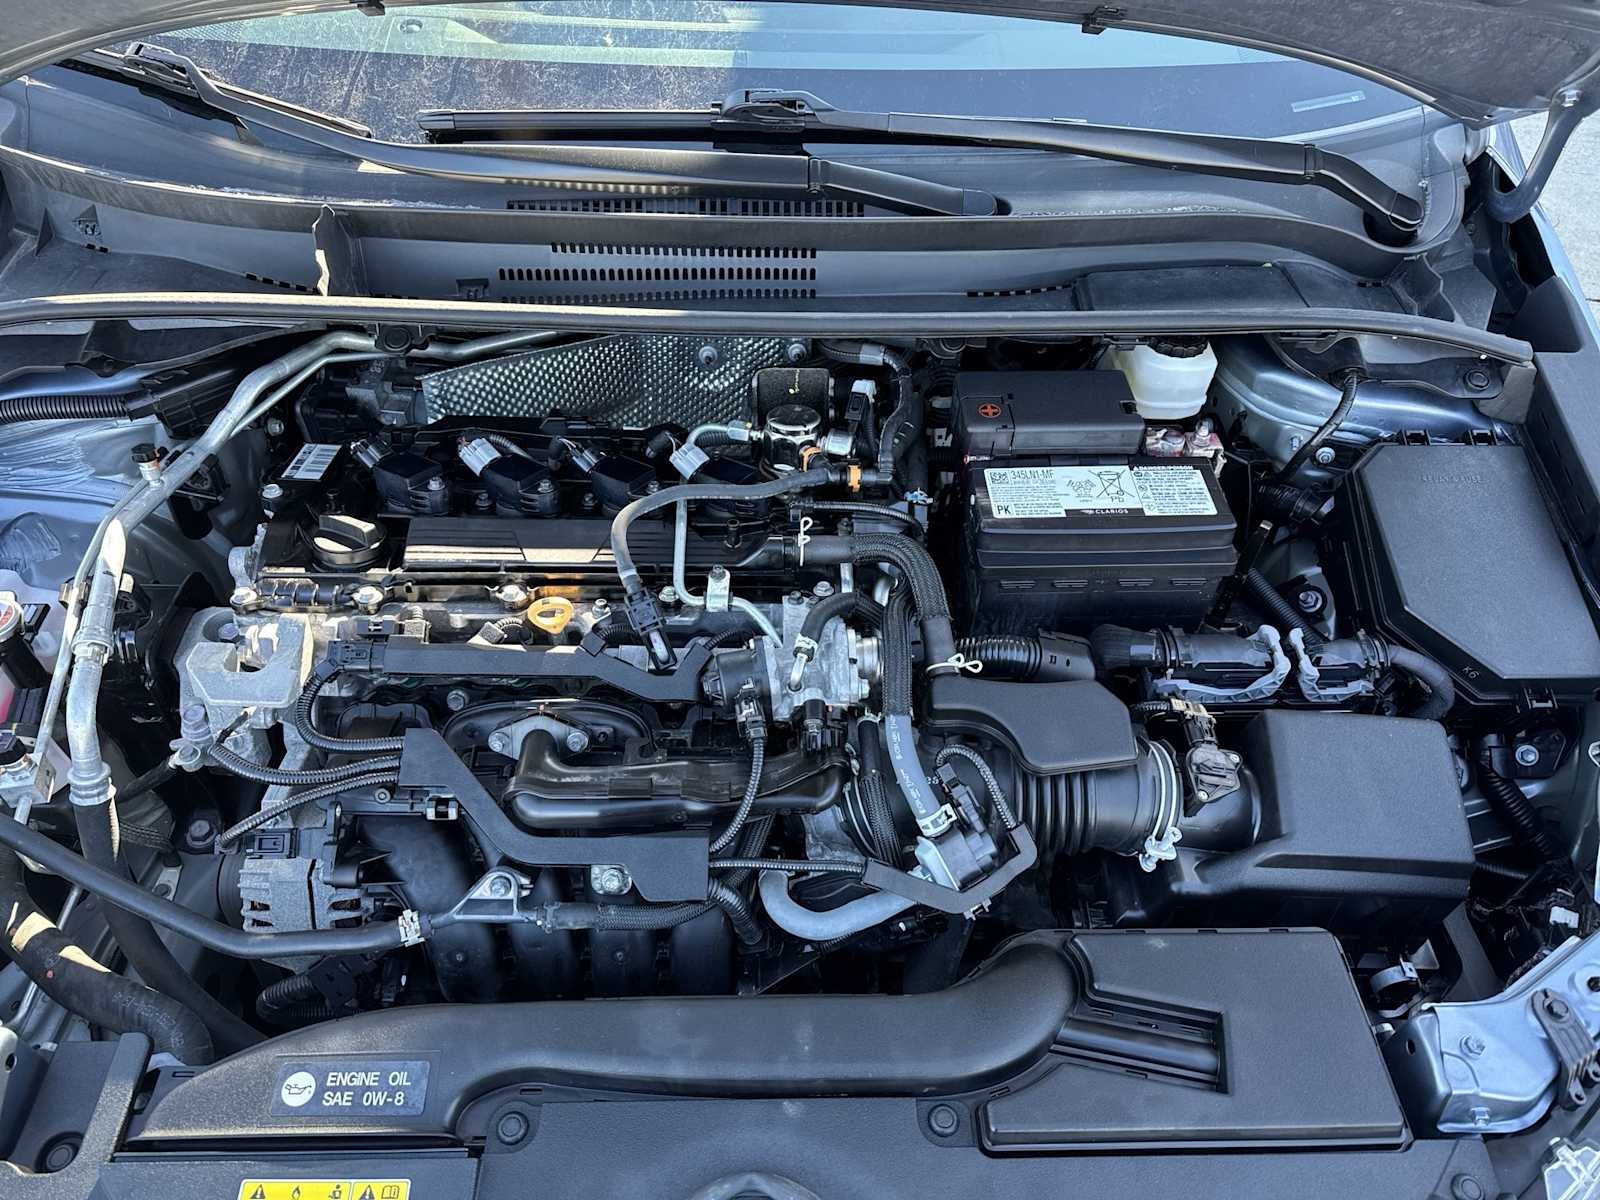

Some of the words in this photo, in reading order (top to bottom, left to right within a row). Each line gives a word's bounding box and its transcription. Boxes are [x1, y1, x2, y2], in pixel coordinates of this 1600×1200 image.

[997, 504, 1011, 515] PK
[326, 1071, 380, 1086] ENGINE
[388, 1071, 412, 1086] OIL
[322, 1091, 354, 1106] SAE
[362, 1091, 405, 1106] 0W-8
